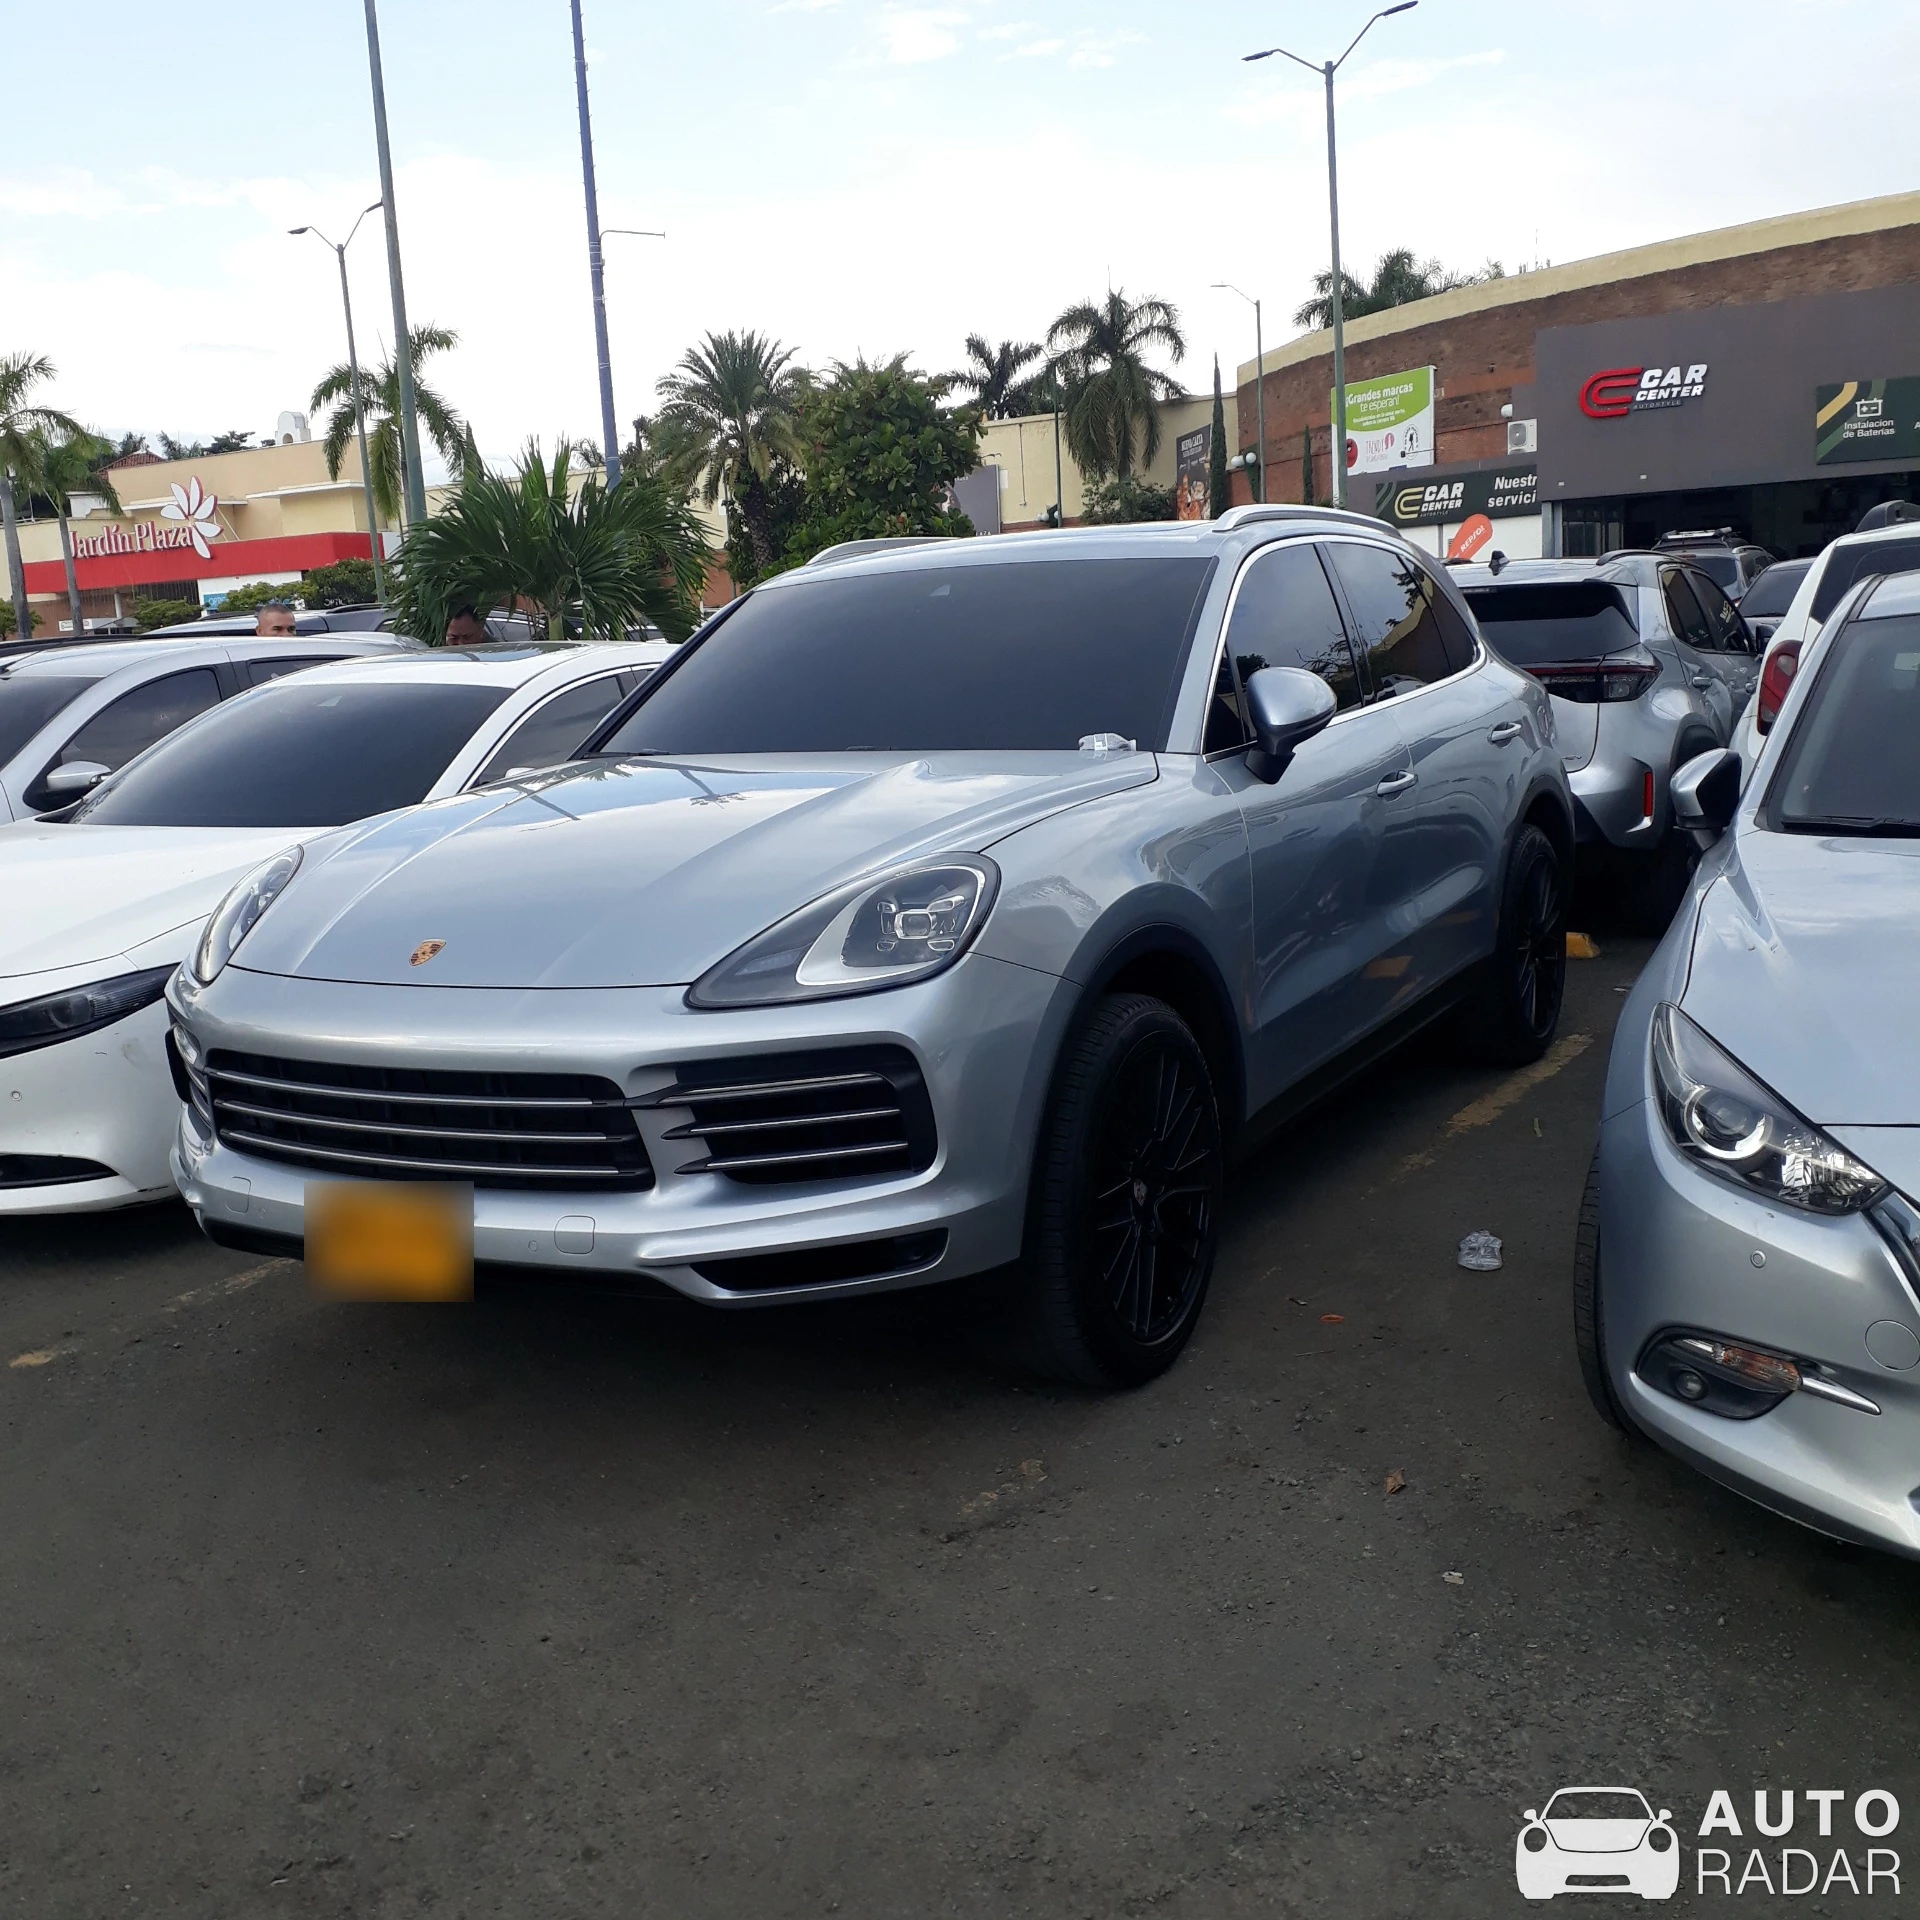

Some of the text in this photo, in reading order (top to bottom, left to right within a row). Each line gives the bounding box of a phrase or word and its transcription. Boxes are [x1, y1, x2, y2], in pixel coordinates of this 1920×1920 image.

[1641, 364, 1708, 389] CAR
[1383, 383, 1413, 397] marcas
[1635, 384, 1705, 402] CENTER
[1360, 402, 1368, 412] te
[1842, 429, 1855, 439] de
[1424, 482, 1465, 501] CAR
[1487, 490, 1537, 508] servici
[1421, 498, 1463, 512] CENTER
[69, 520, 195, 559] Jardín Plaza
[1460, 524, 1486, 552] REPSOL
